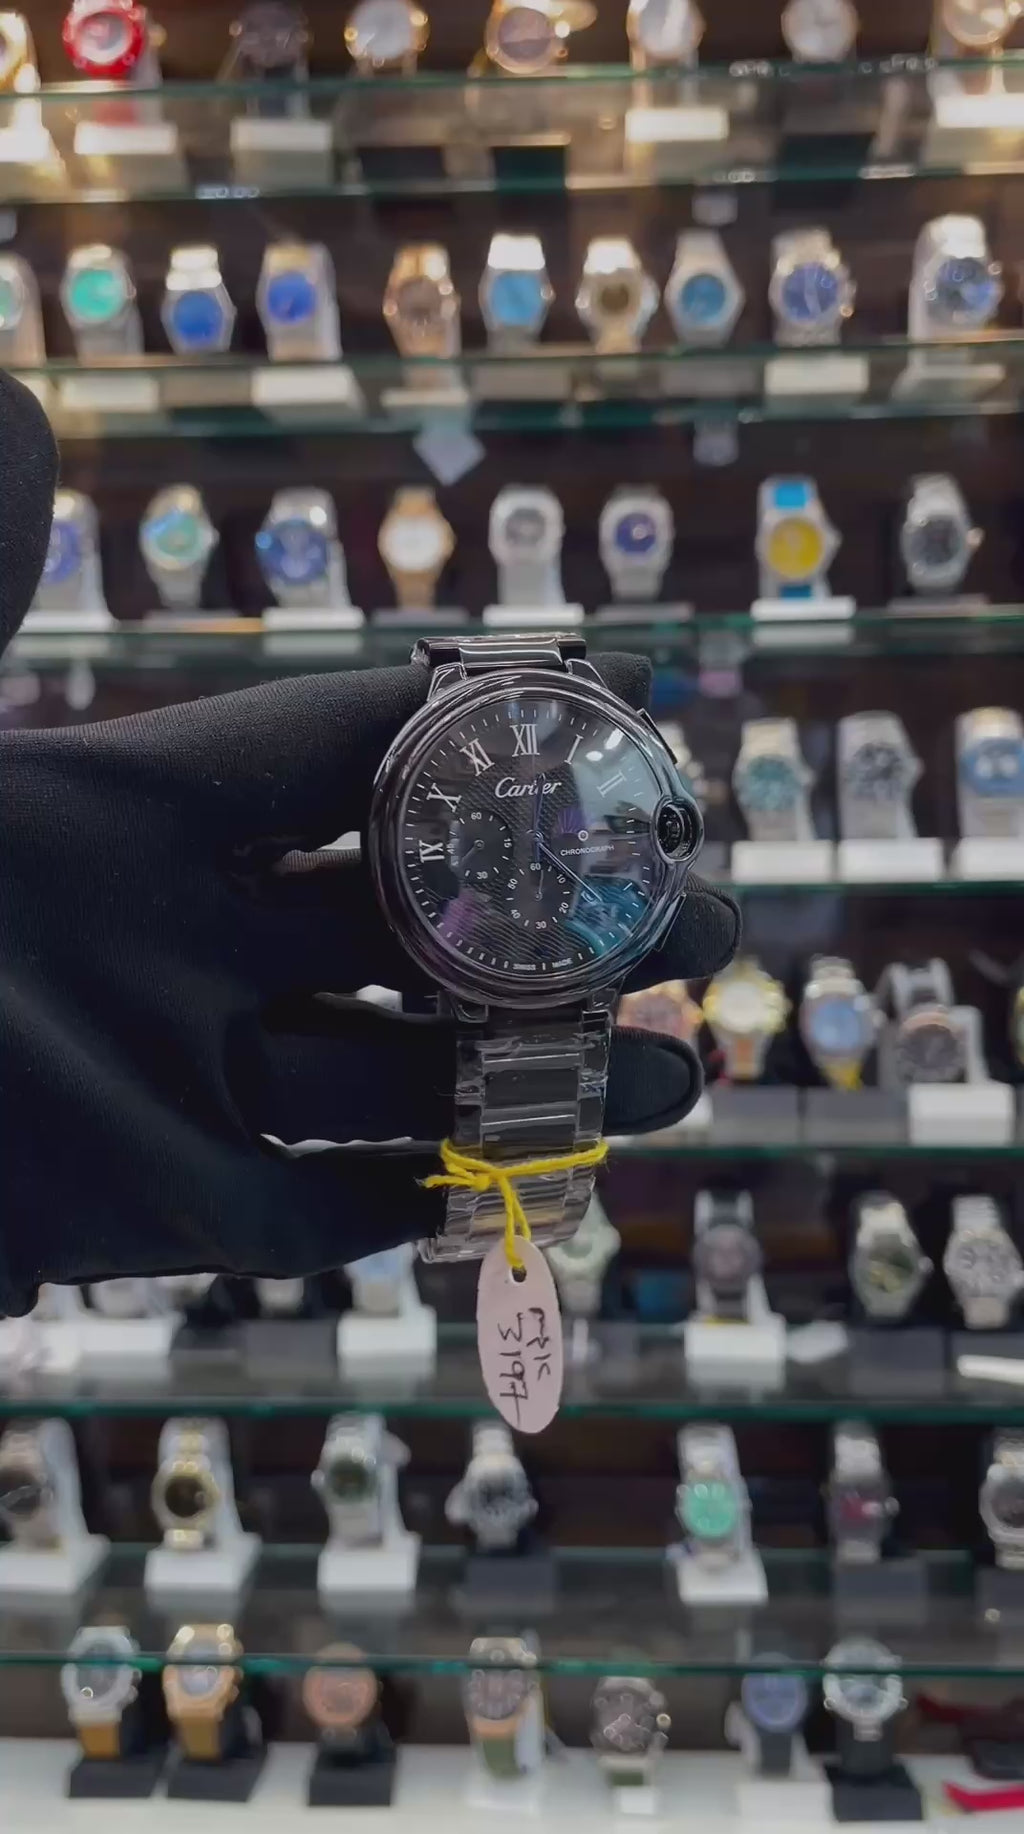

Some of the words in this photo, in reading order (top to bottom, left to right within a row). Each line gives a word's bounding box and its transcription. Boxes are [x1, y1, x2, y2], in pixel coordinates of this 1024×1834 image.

[509, 723, 541, 757] XII
[459, 737, 495, 777] XI
[427, 782, 462, 813] X
[471, 811, 482, 820] 60
[503, 838, 513, 849] 15
[418, 839, 445, 865] IX
[560, 844, 616, 857] CHRONOGRAPH
[530, 862, 541, 871] 60
[476, 871, 489, 879] 30
[556, 873, 566, 884] 10
[507, 878, 519, 890] 50
[510, 908, 521, 919] 40
[558, 902, 569, 914] 20
[535, 921, 547, 930] 30
